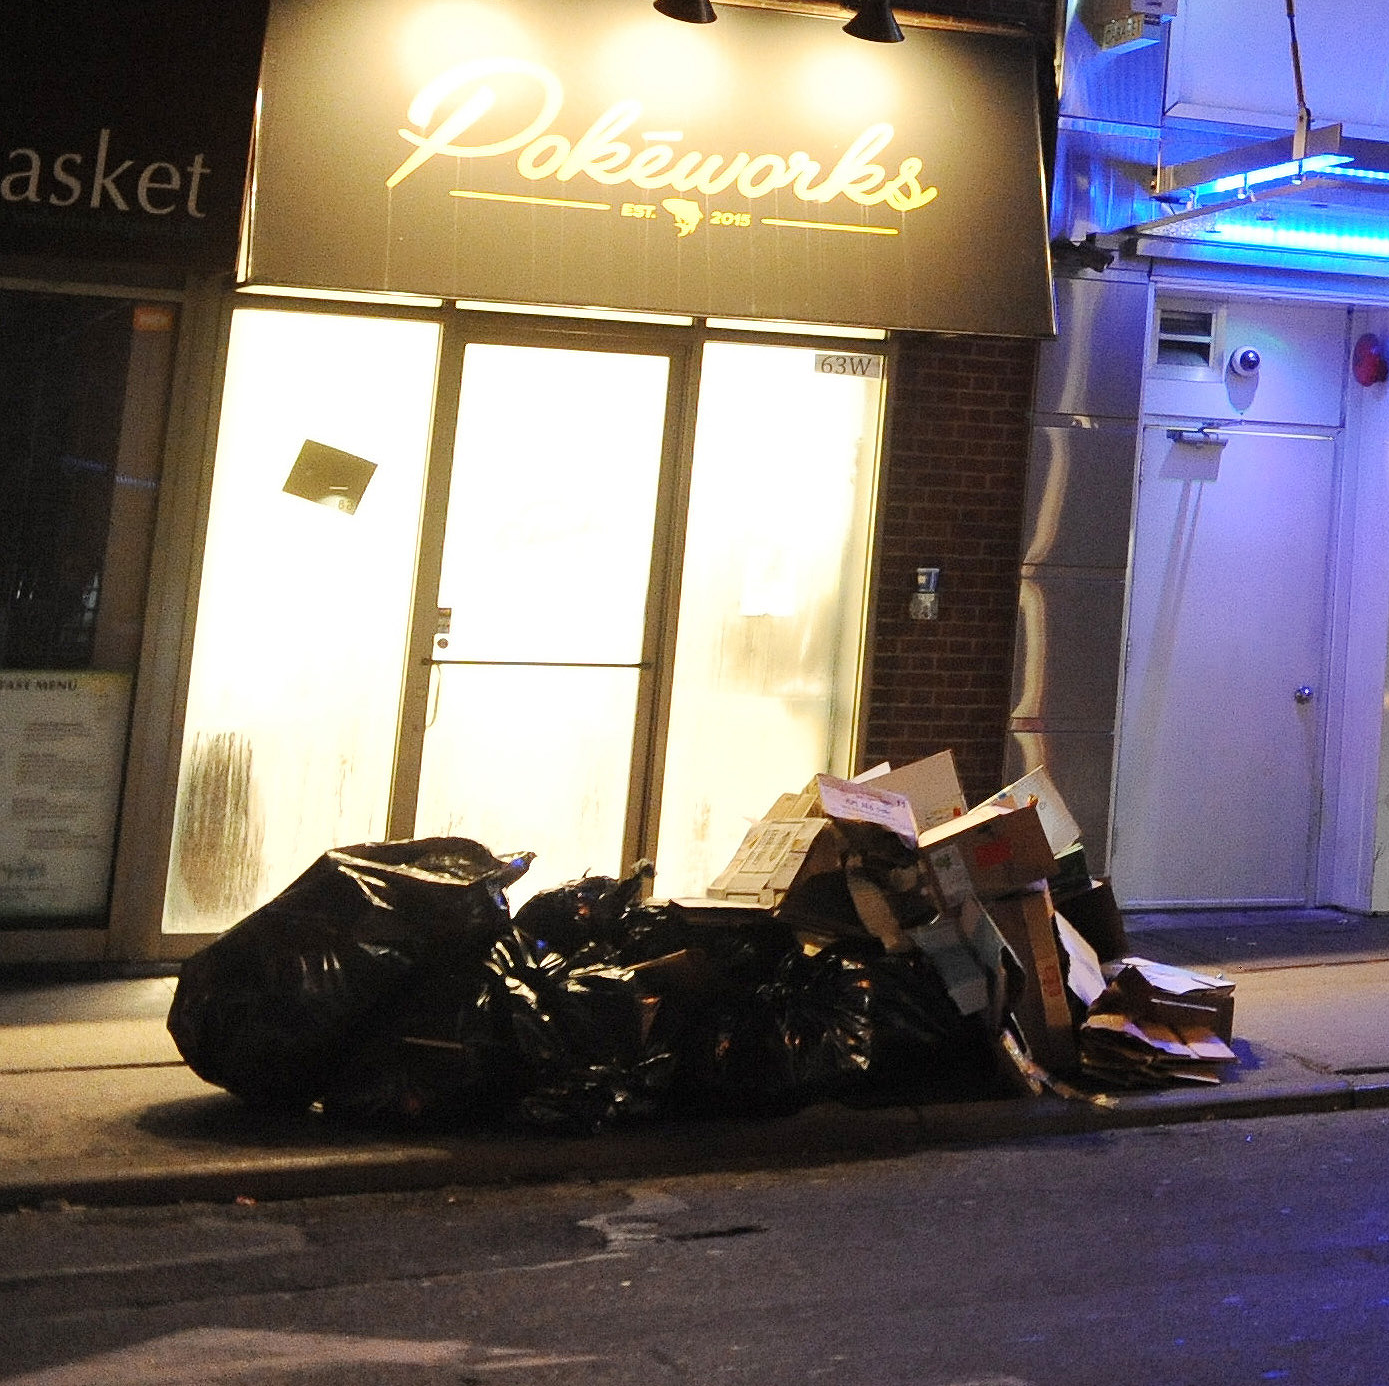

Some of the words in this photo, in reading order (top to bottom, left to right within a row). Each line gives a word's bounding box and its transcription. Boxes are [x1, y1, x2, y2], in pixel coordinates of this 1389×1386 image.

[621, 203, 656, 219] EST.
[710, 211, 751, 227] 2015
[821, 355, 873, 375] 63W
